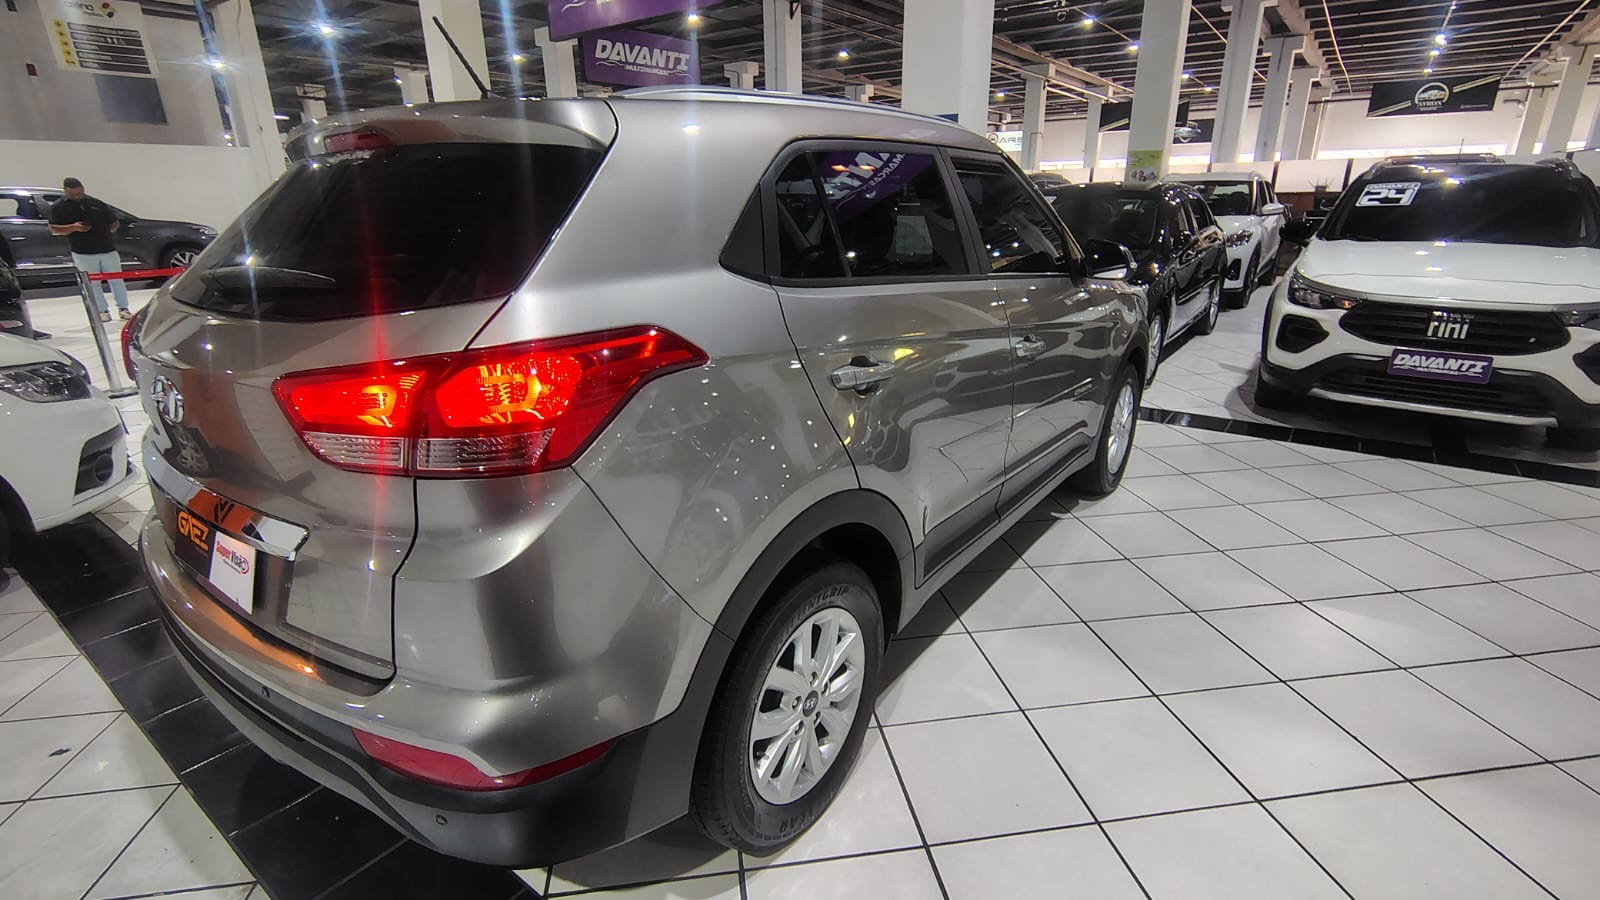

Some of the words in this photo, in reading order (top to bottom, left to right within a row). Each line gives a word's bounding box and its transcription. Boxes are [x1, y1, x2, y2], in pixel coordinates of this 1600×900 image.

[595, 39, 691, 71] DAVANTI
[1360, 188, 1415, 205] 24
[1393, 352, 1489, 374] DAVANTI
